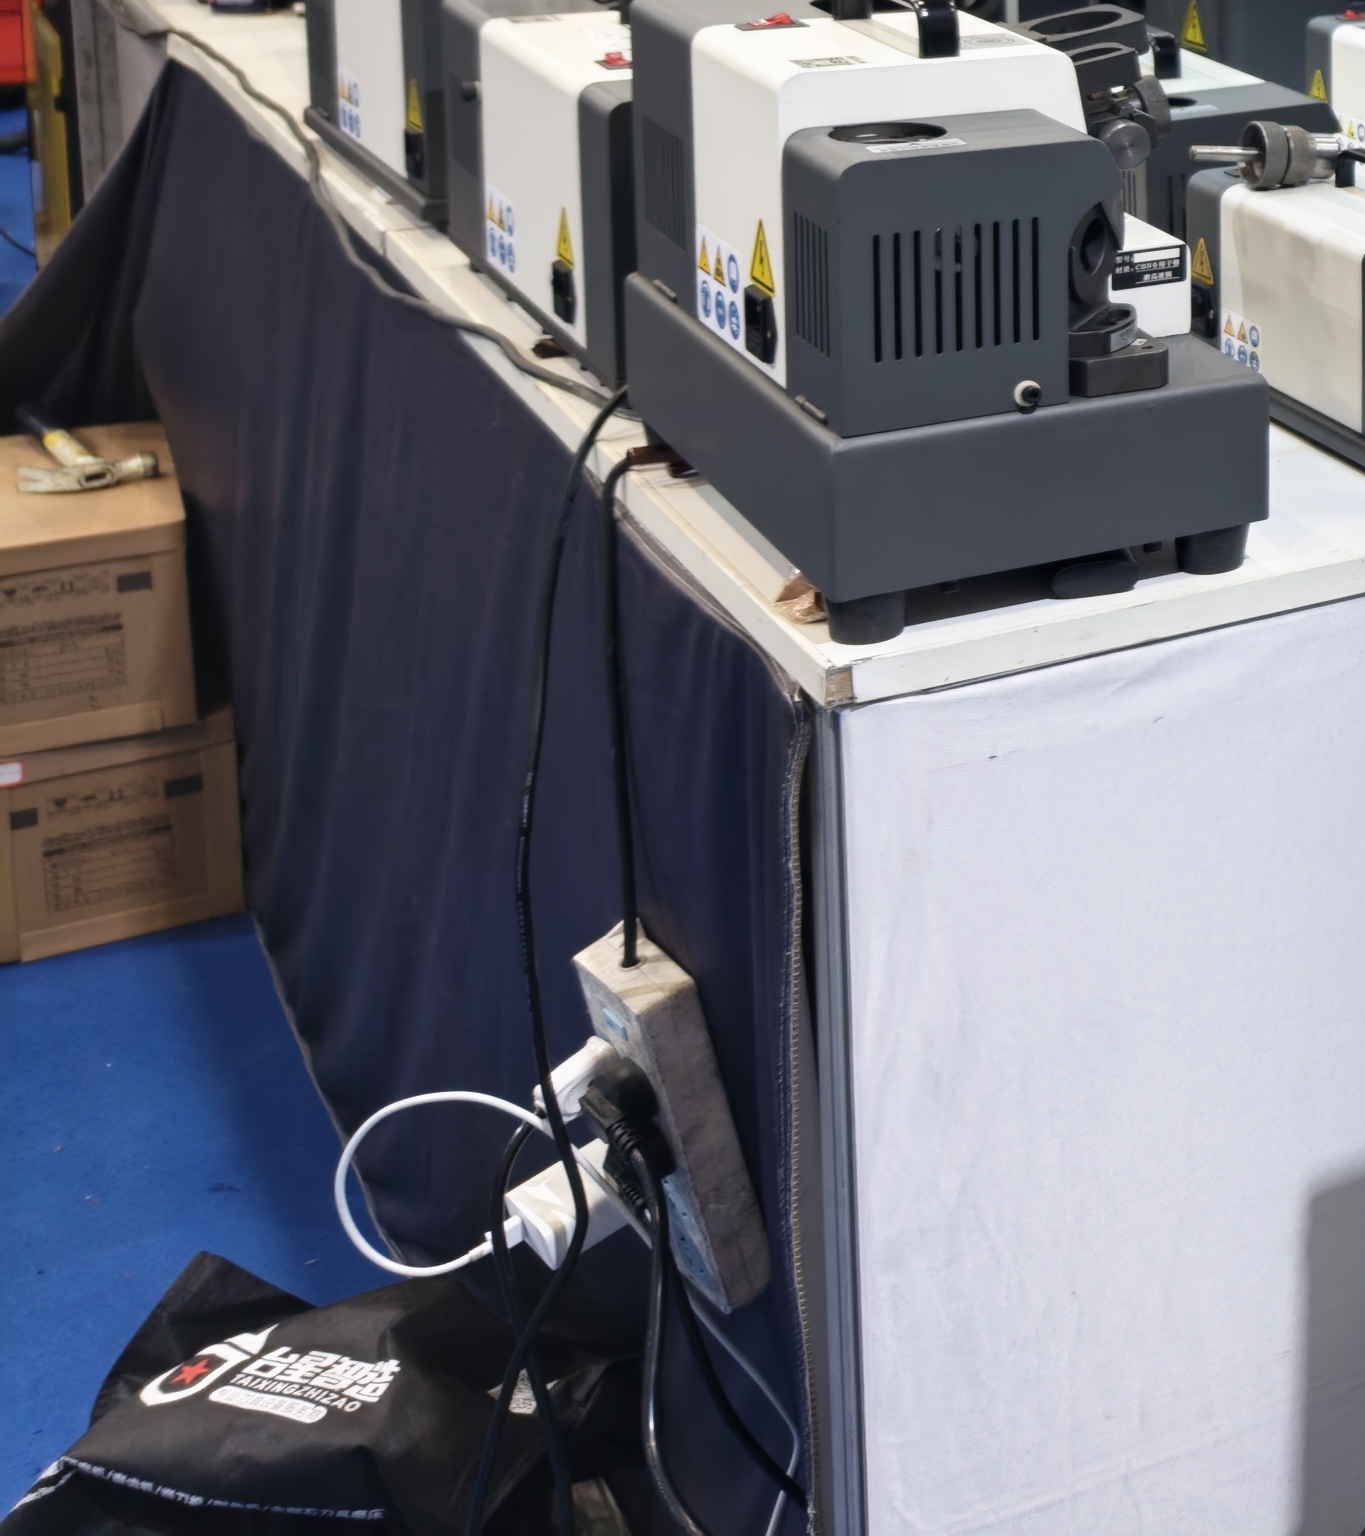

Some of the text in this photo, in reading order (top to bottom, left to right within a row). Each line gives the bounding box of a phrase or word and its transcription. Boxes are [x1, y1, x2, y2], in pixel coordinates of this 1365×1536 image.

[230, 1374, 363, 1414] TAIXINGZHIZAO
[240, 1346, 402, 1404] 台星智造
